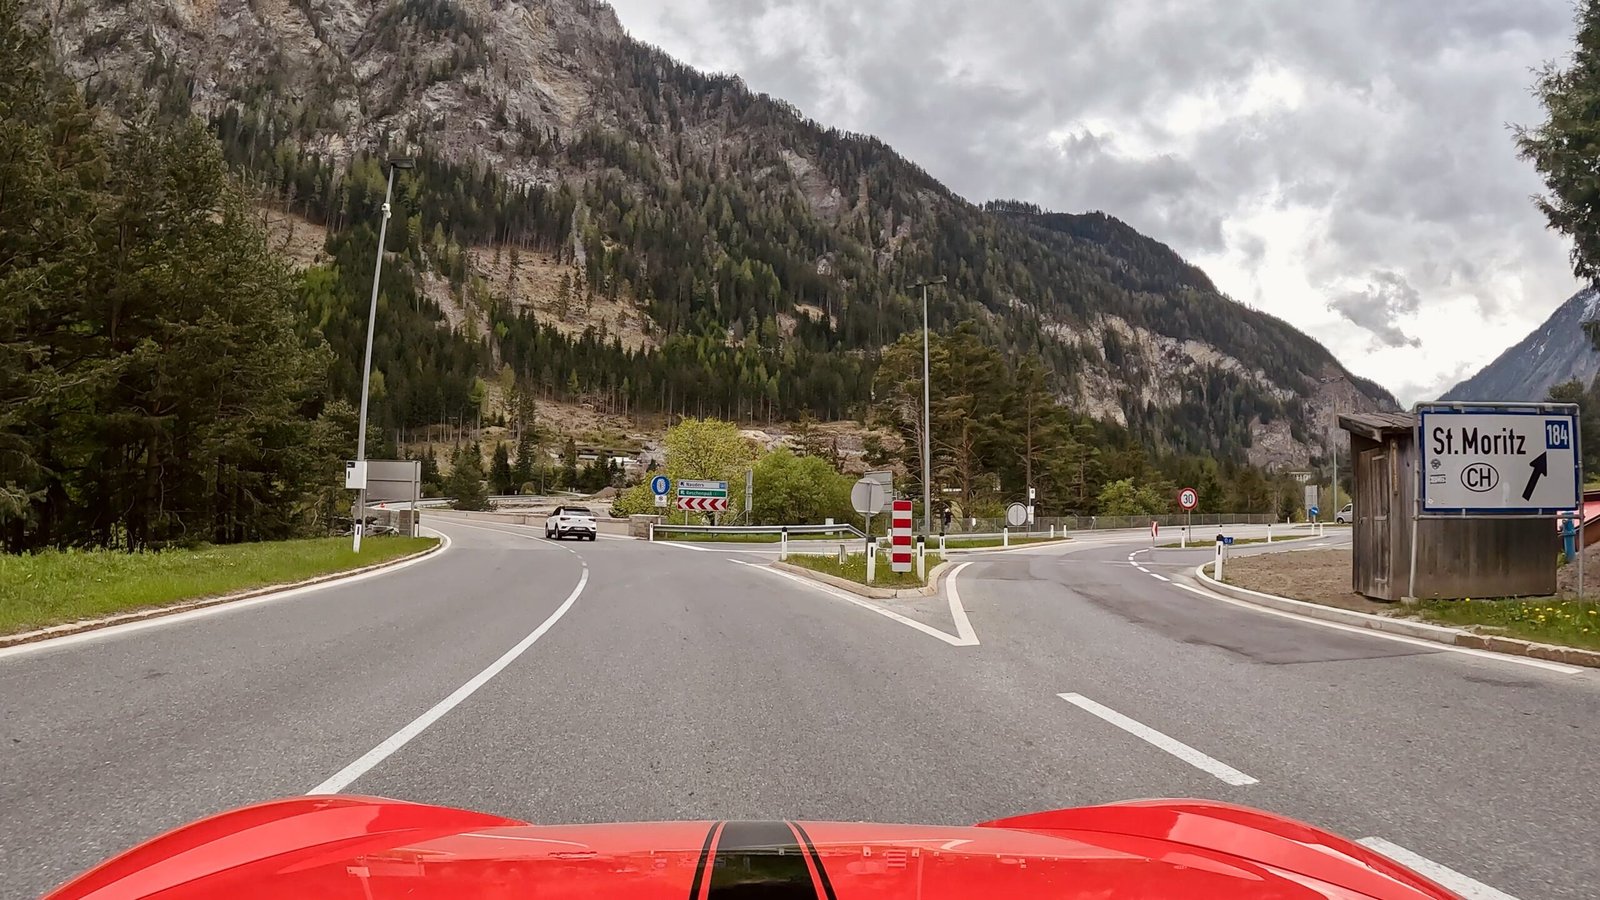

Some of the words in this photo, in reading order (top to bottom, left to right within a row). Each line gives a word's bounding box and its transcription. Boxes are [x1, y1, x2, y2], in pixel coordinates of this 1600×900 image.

[1546, 424, 1568, 446] 184
[1466, 468, 1491, 487] CH
[1183, 493, 1193, 504] 30
